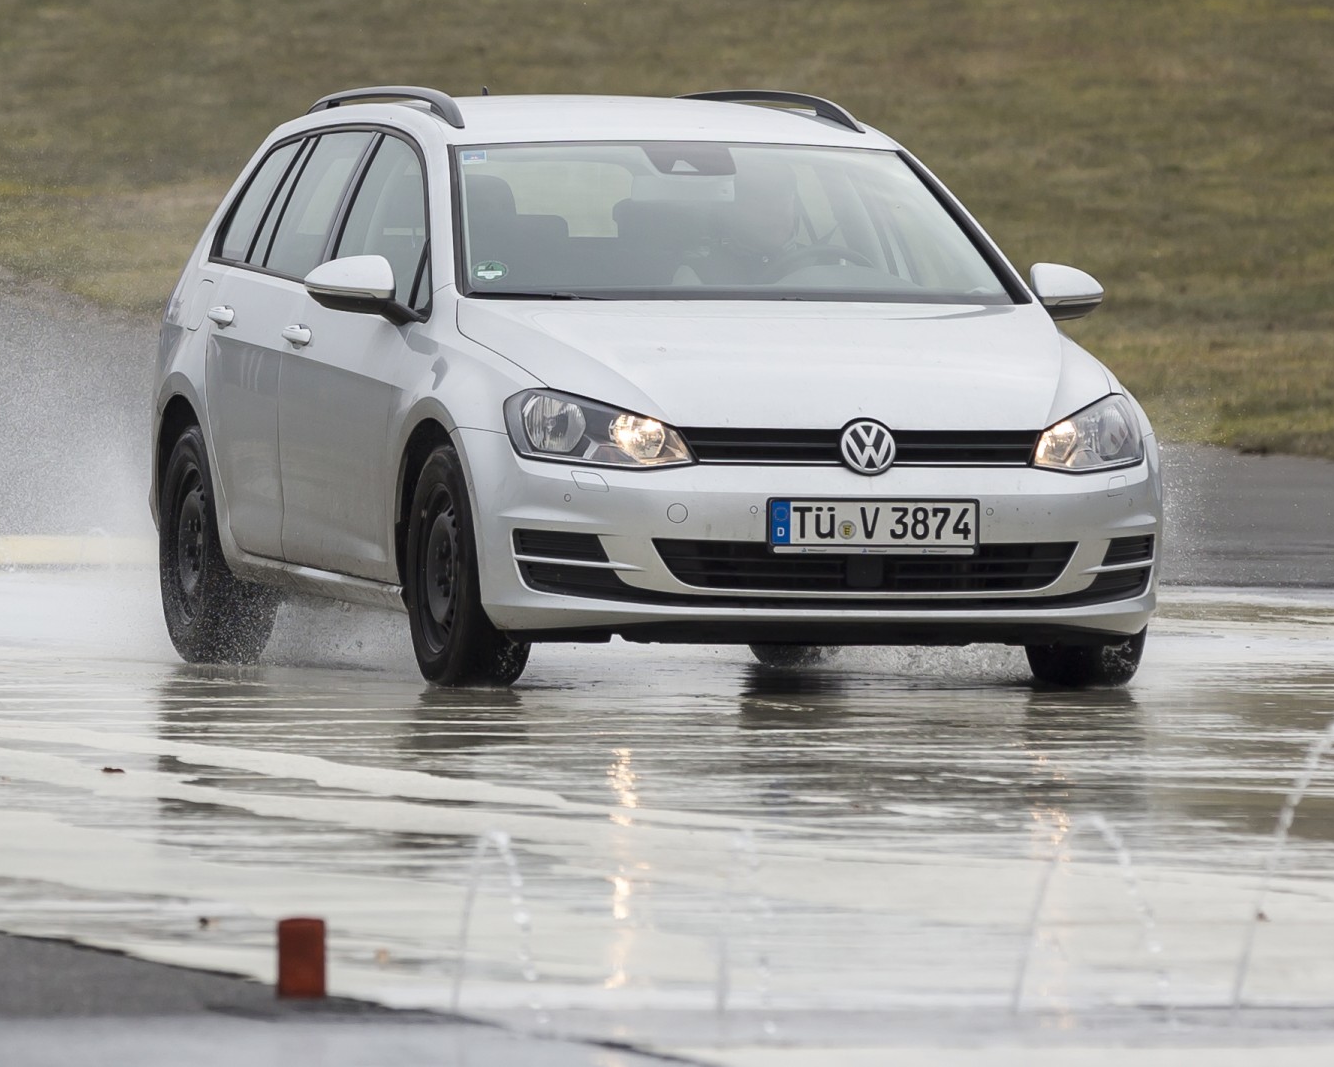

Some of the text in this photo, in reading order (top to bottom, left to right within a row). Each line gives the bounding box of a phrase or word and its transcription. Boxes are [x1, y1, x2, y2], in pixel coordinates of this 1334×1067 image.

[777, 527, 785, 537] D
[792, 506, 972, 540] TÜ V 3874
